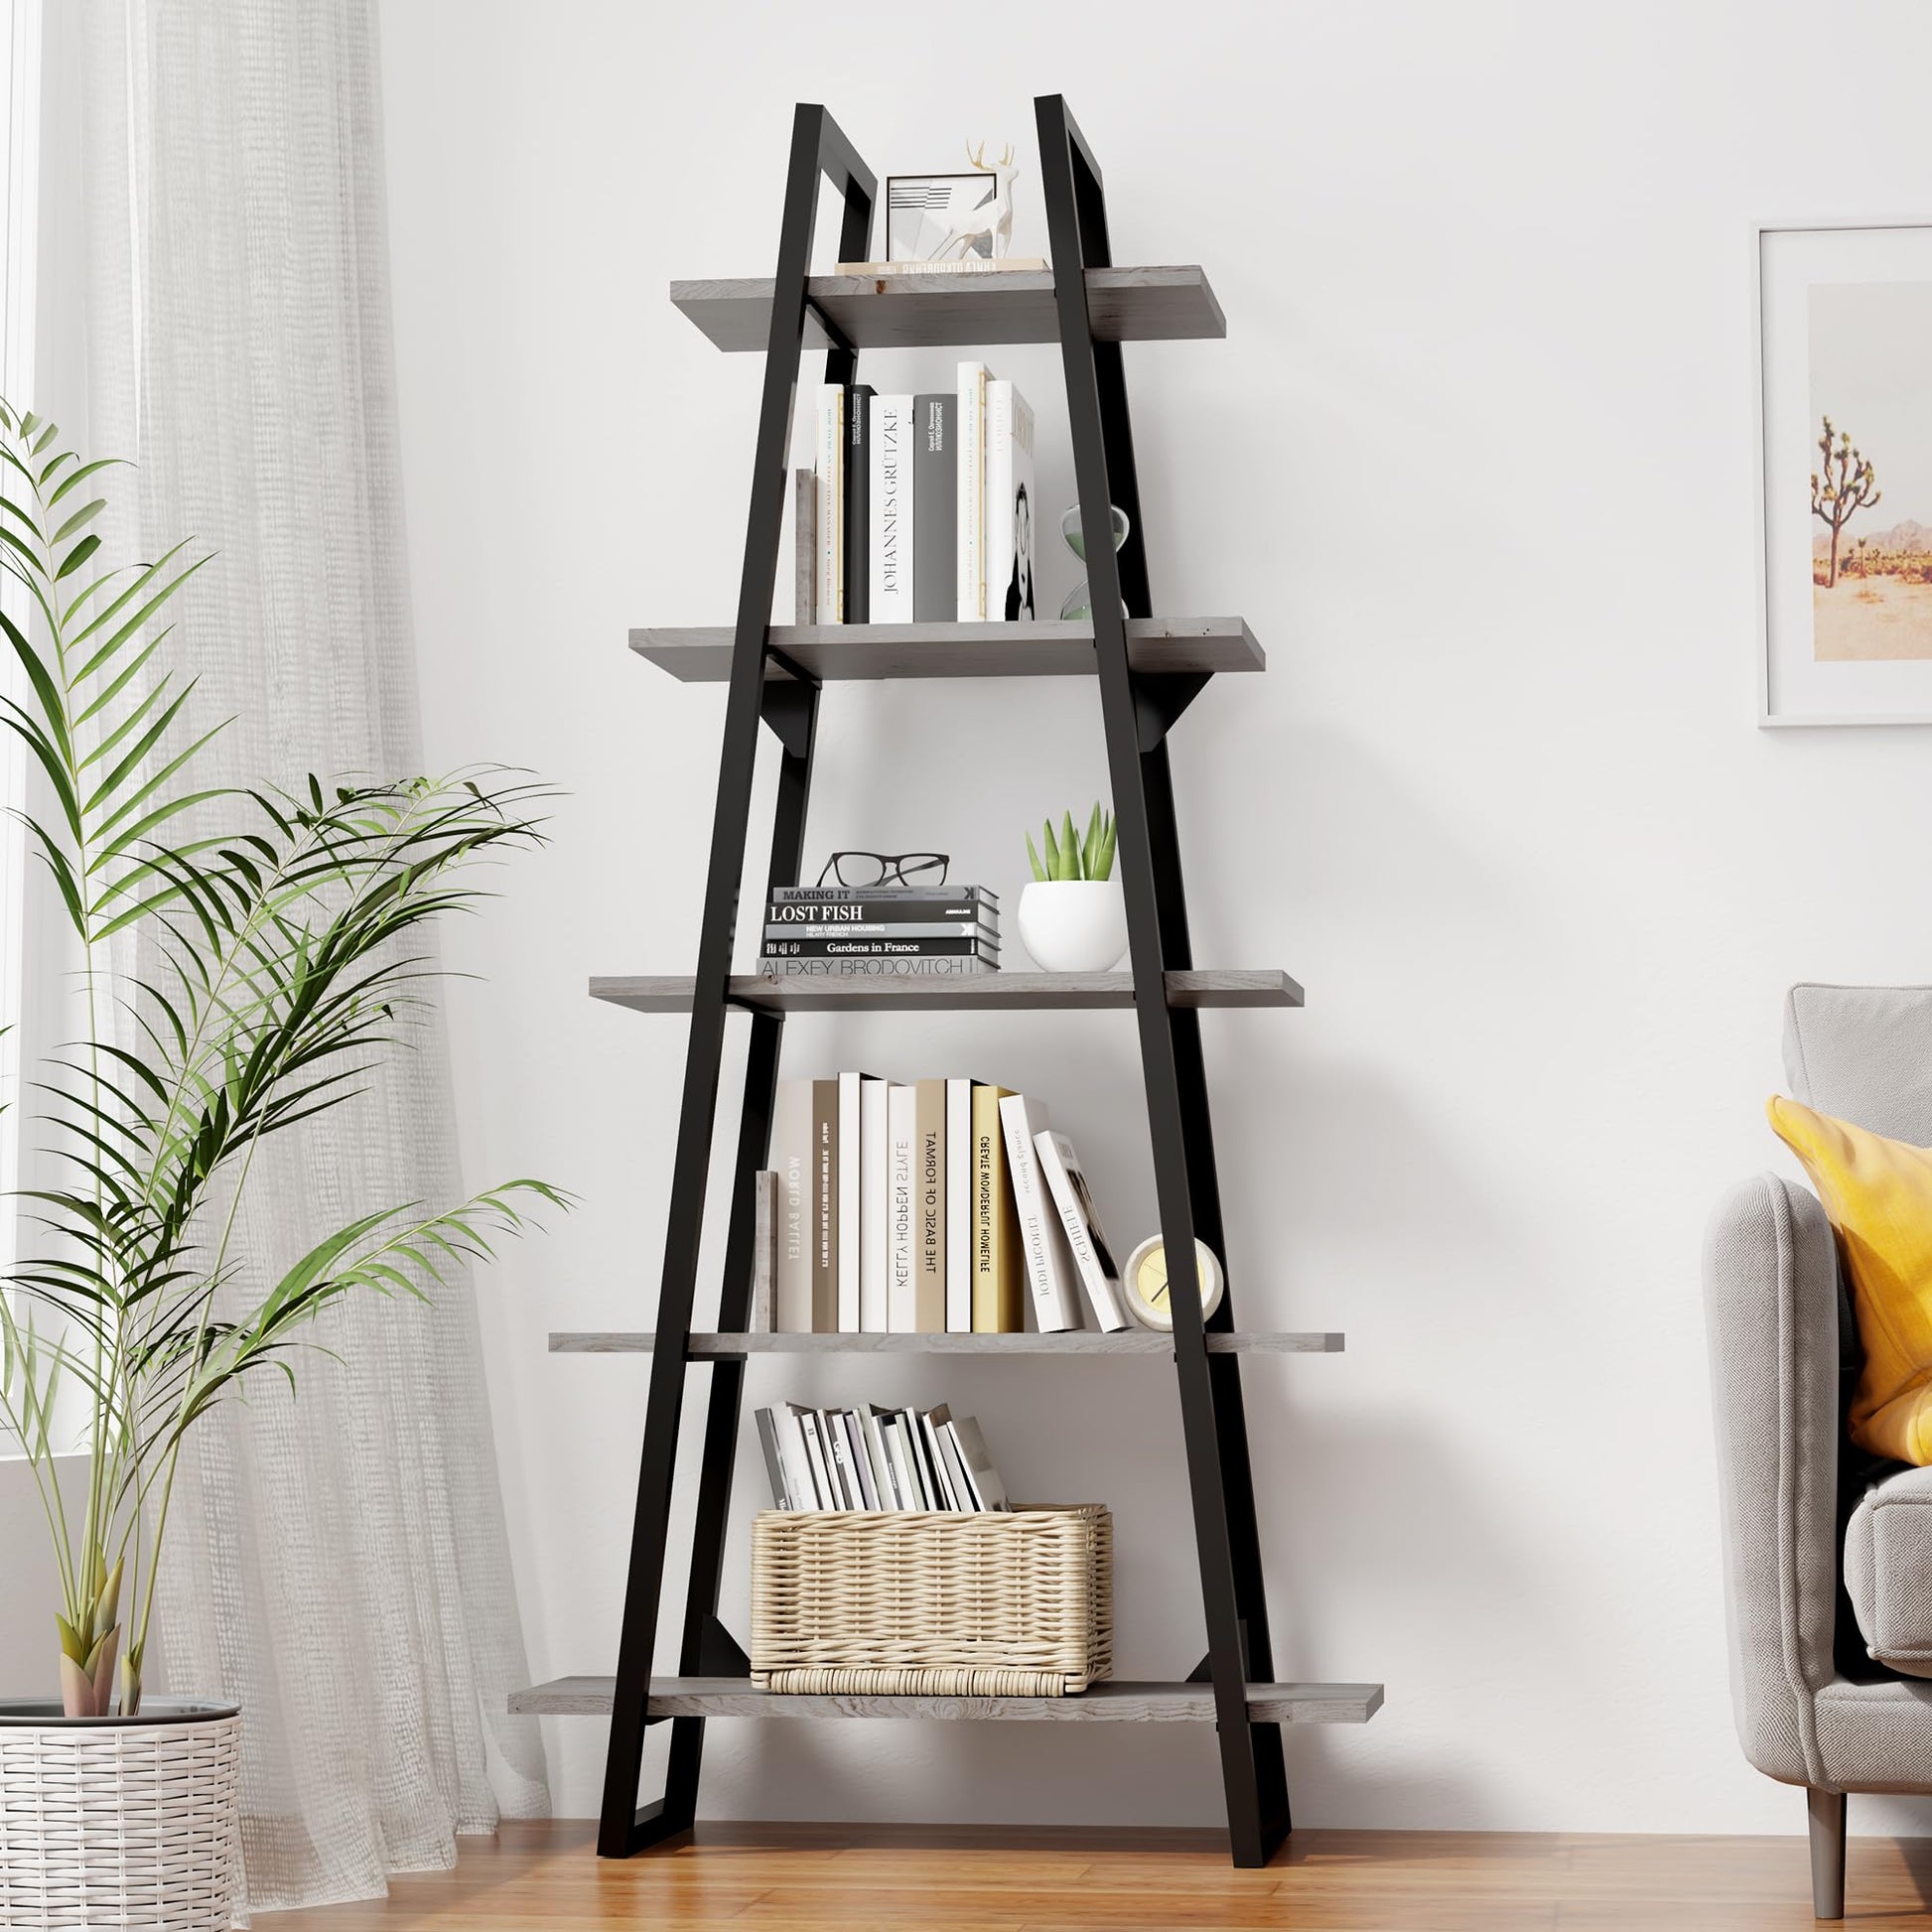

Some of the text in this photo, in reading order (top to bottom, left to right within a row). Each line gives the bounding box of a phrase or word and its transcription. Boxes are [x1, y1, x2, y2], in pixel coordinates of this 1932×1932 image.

[883, 409, 898, 594] JOHANNES GRÜTZKE
[782, 891, 834, 900] MAKING
[837, 891, 851, 899] IT
[769, 904, 864, 922] LOST FISH
[826, 942, 919, 953] Gardens in France
[761, 959, 835, 976] ALEXEY
[841, 958, 963, 975] BRODOVITCH
